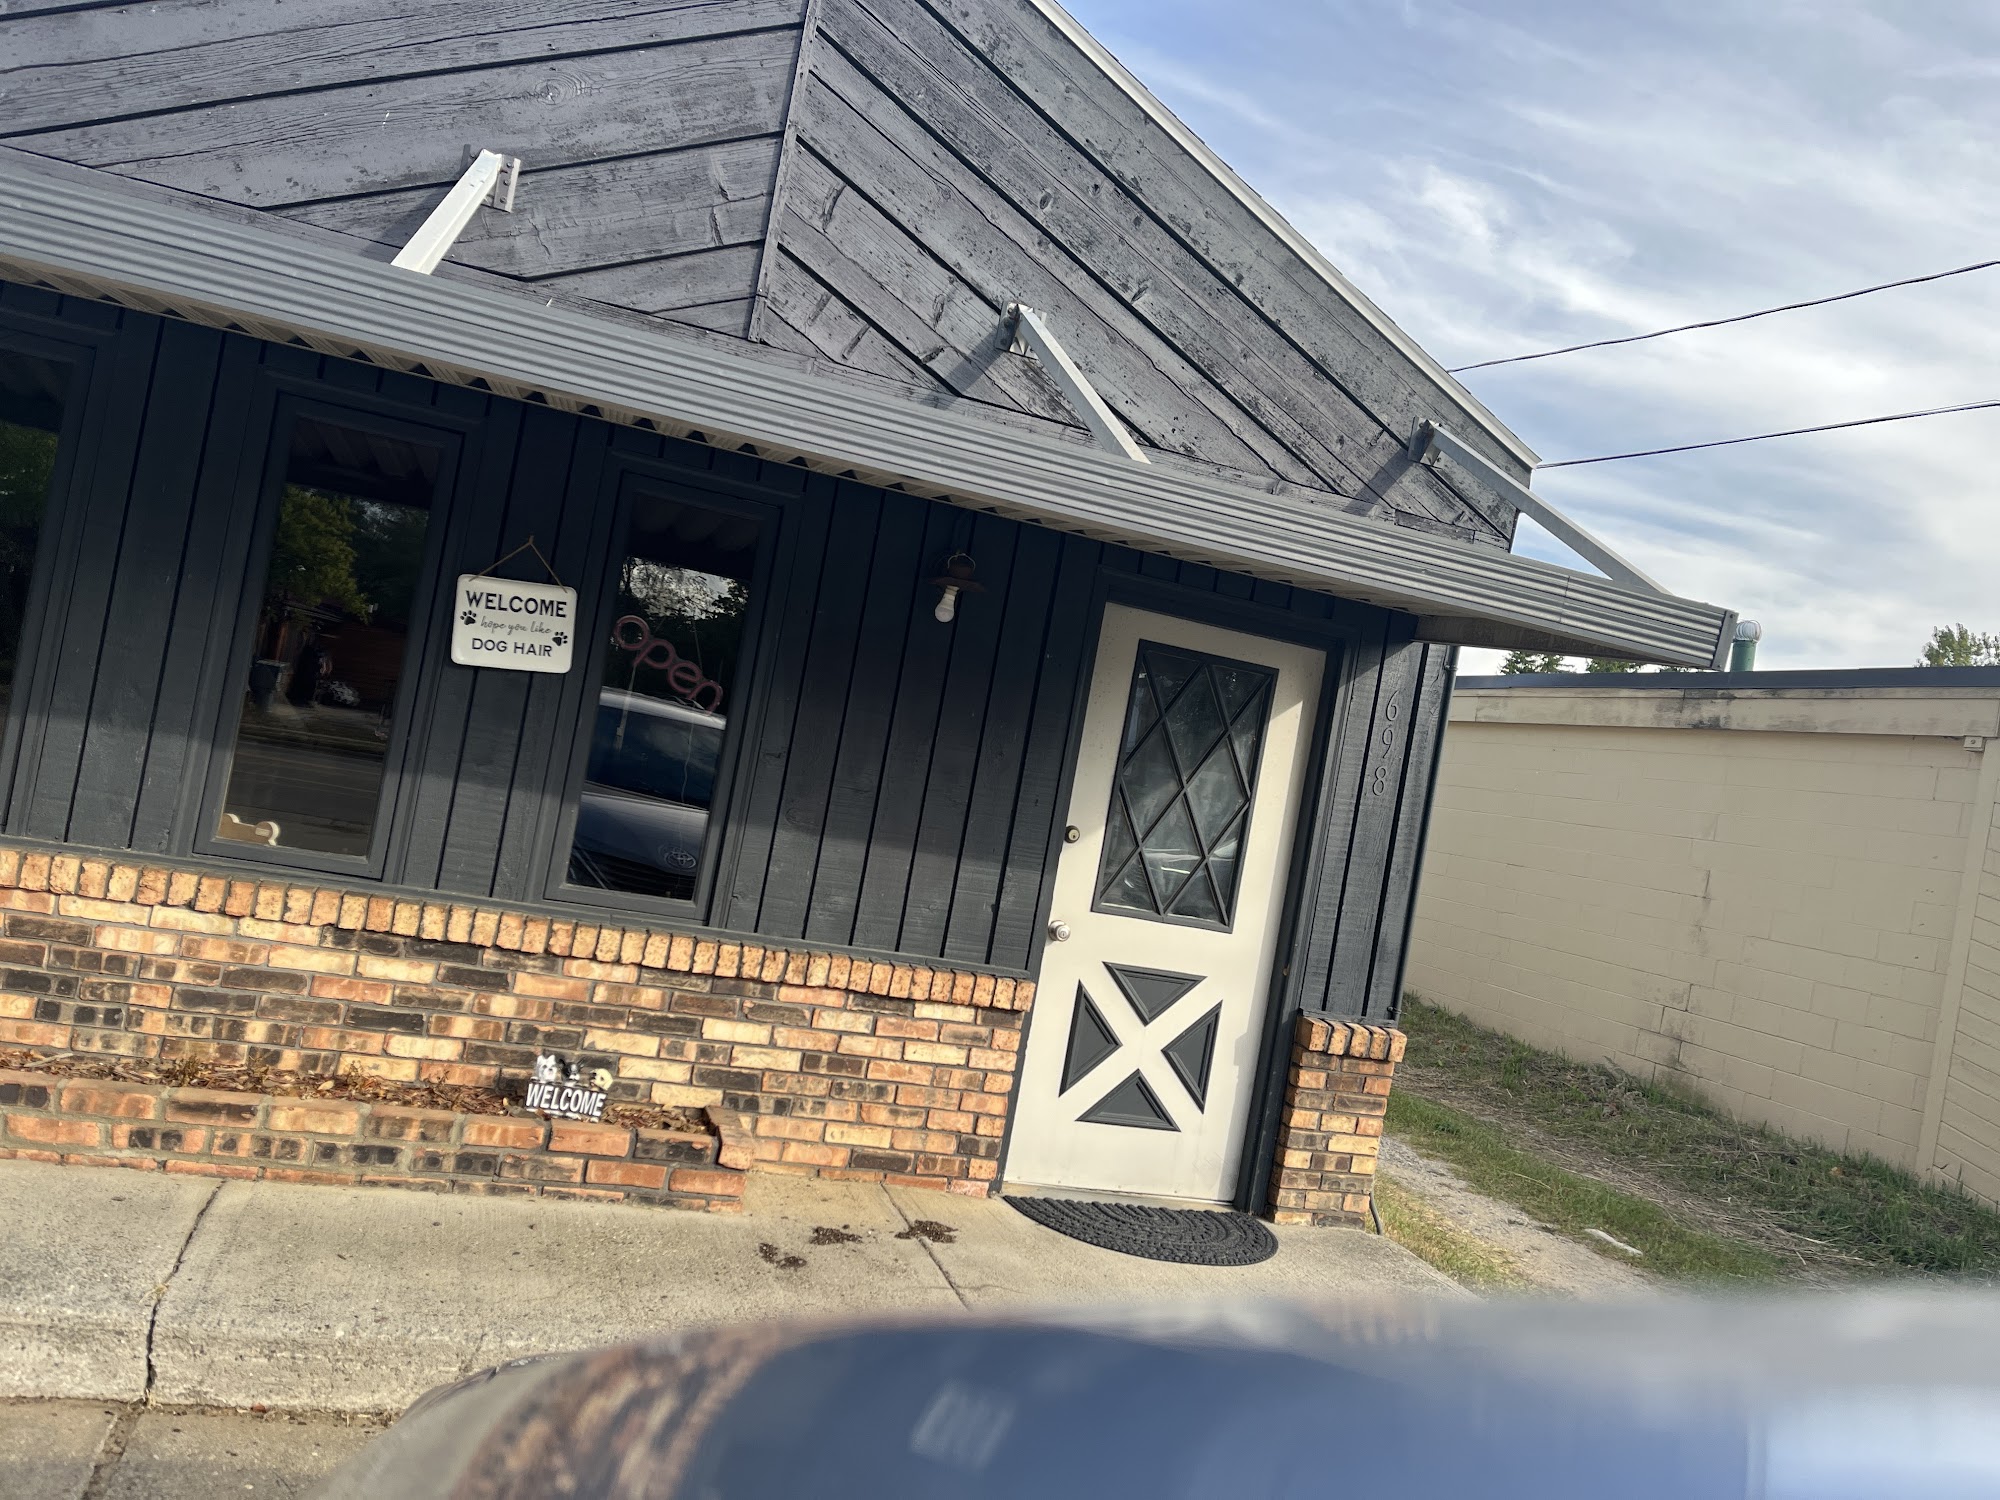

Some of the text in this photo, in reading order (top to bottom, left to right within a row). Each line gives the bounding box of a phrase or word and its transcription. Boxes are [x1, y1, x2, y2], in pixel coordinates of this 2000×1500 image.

[465, 590, 567, 618] WELCOME
[480, 616, 552, 635] hope you like
[471, 638, 552, 657] DOG HAIR
[613, 615, 723, 716] open
[1372, 690, 1399, 796] 698
[525, 1083, 607, 1117] WELCOME
